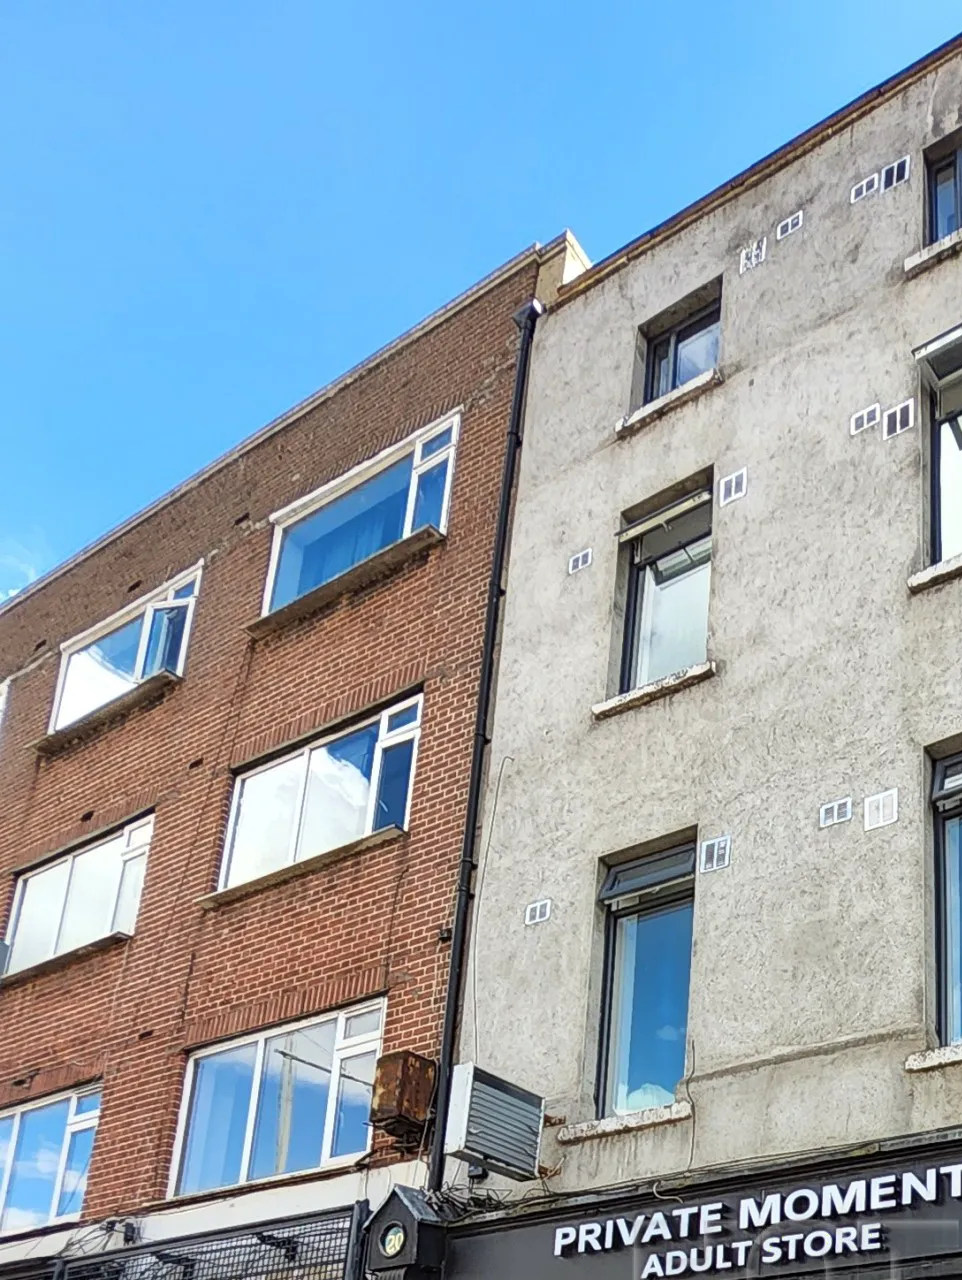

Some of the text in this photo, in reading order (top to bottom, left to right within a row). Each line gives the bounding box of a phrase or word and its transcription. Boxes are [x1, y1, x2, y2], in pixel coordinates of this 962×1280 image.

[385, 1232, 404, 1255] 20
[553, 1201, 723, 1257] PRIVATE
[640, 1223, 881, 1279] ADULT STORE
